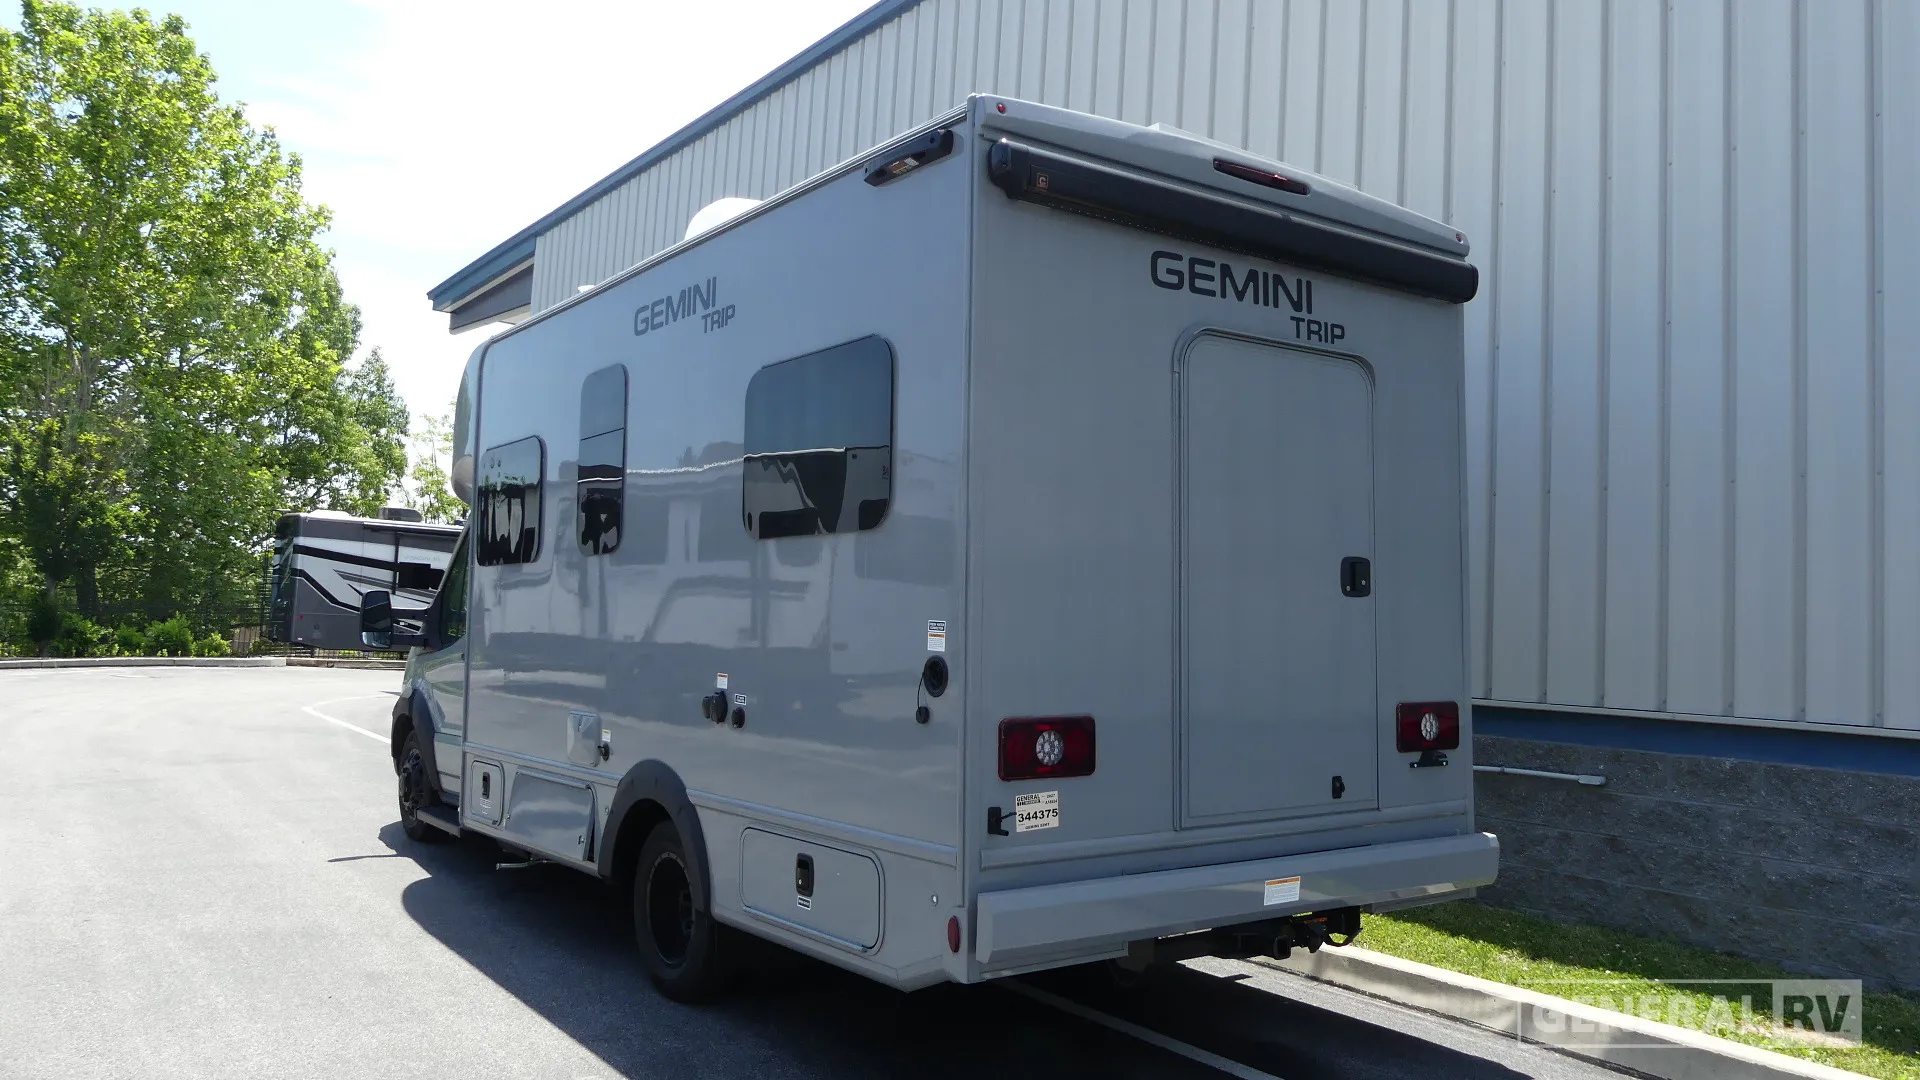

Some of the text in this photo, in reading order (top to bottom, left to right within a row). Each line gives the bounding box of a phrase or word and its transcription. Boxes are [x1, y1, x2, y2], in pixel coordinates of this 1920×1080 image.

[1150, 250, 1313, 314] GEMINI
[633, 276, 717, 337] GEMINI
[701, 304, 736, 334] TRIP
[1290, 315, 1345, 344] TRIP
[1018, 808, 1058, 822] 344375
